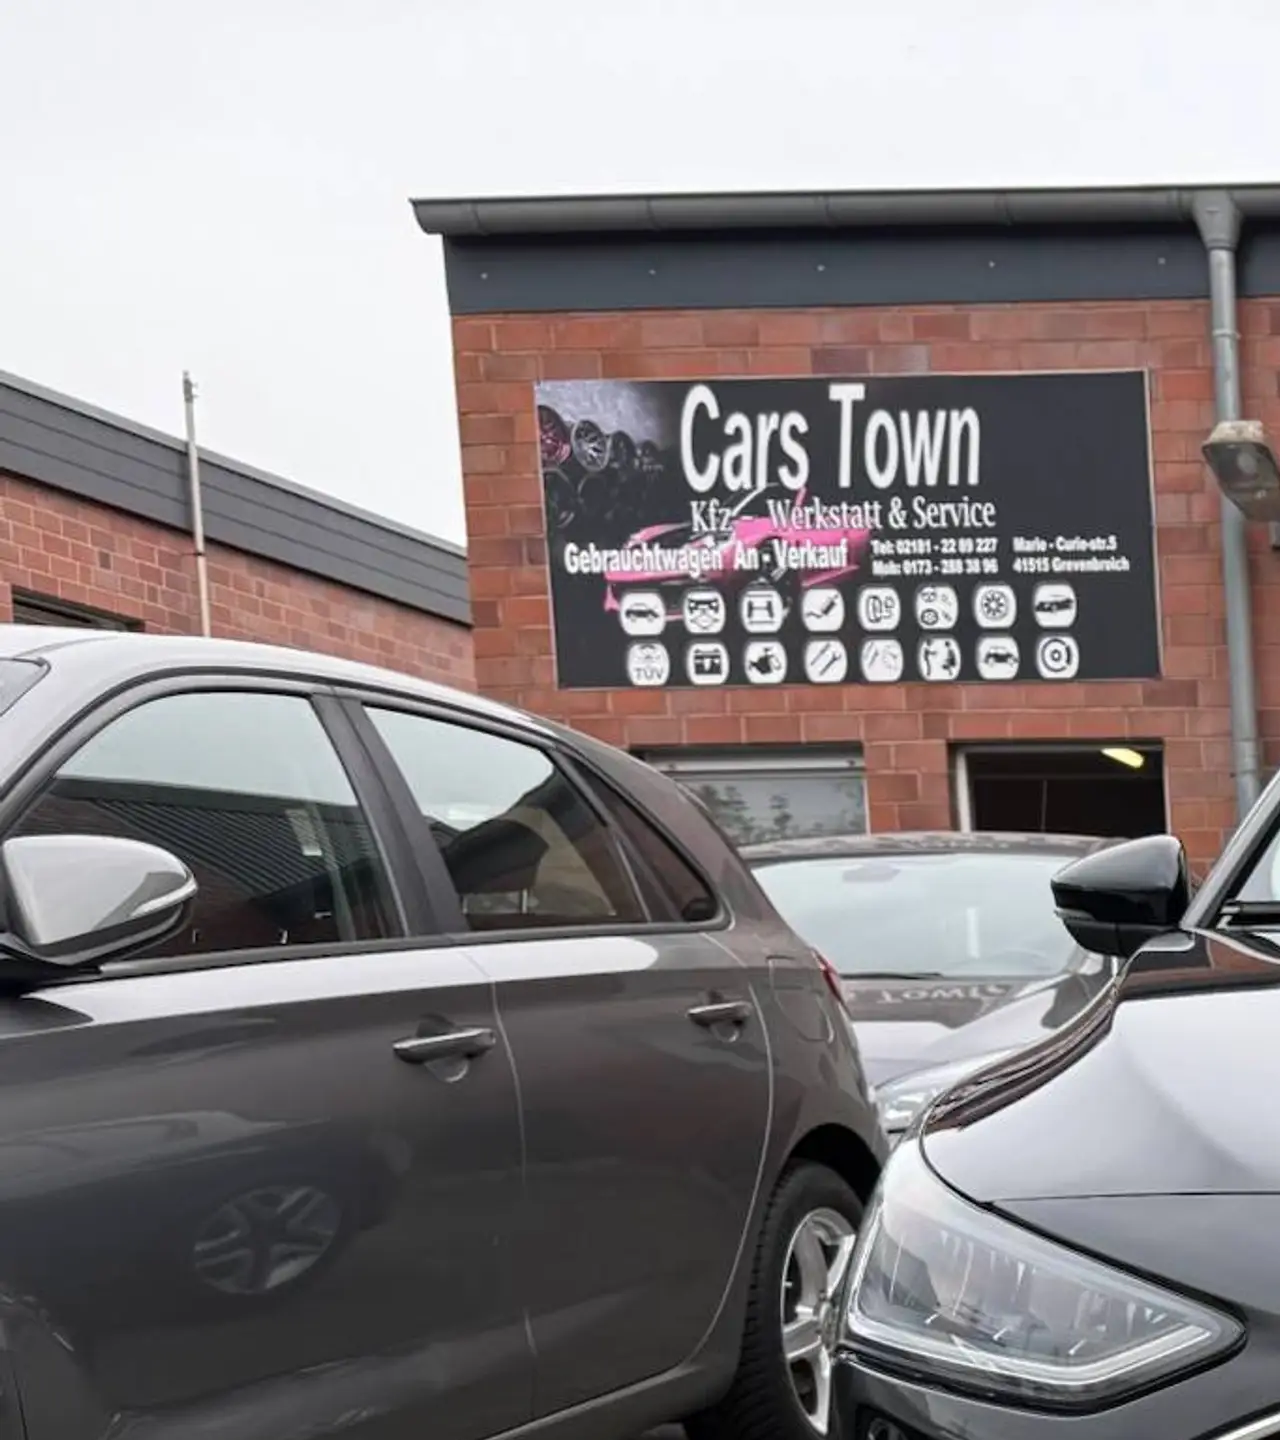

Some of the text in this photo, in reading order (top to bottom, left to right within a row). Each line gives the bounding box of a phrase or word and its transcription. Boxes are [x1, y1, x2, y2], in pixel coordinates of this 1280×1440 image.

[680, 383, 981, 493] Cars Town
[689, 498, 734, 533] Kfz
[766, 497, 883, 531] Werkstatt
[888, 495, 908, 529] &
[911, 495, 997, 529] Service
[563, 542, 723, 580] Gebrauchtwagen
[732, 540, 760, 571] An
[772, 537, 849, 571] Verkauf
[941, 538, 957, 554] 22
[975, 537, 998, 554] 227
[902, 559, 932, 576] 0173
[1012, 555, 1130, 573] 41515 Grevenbroich
